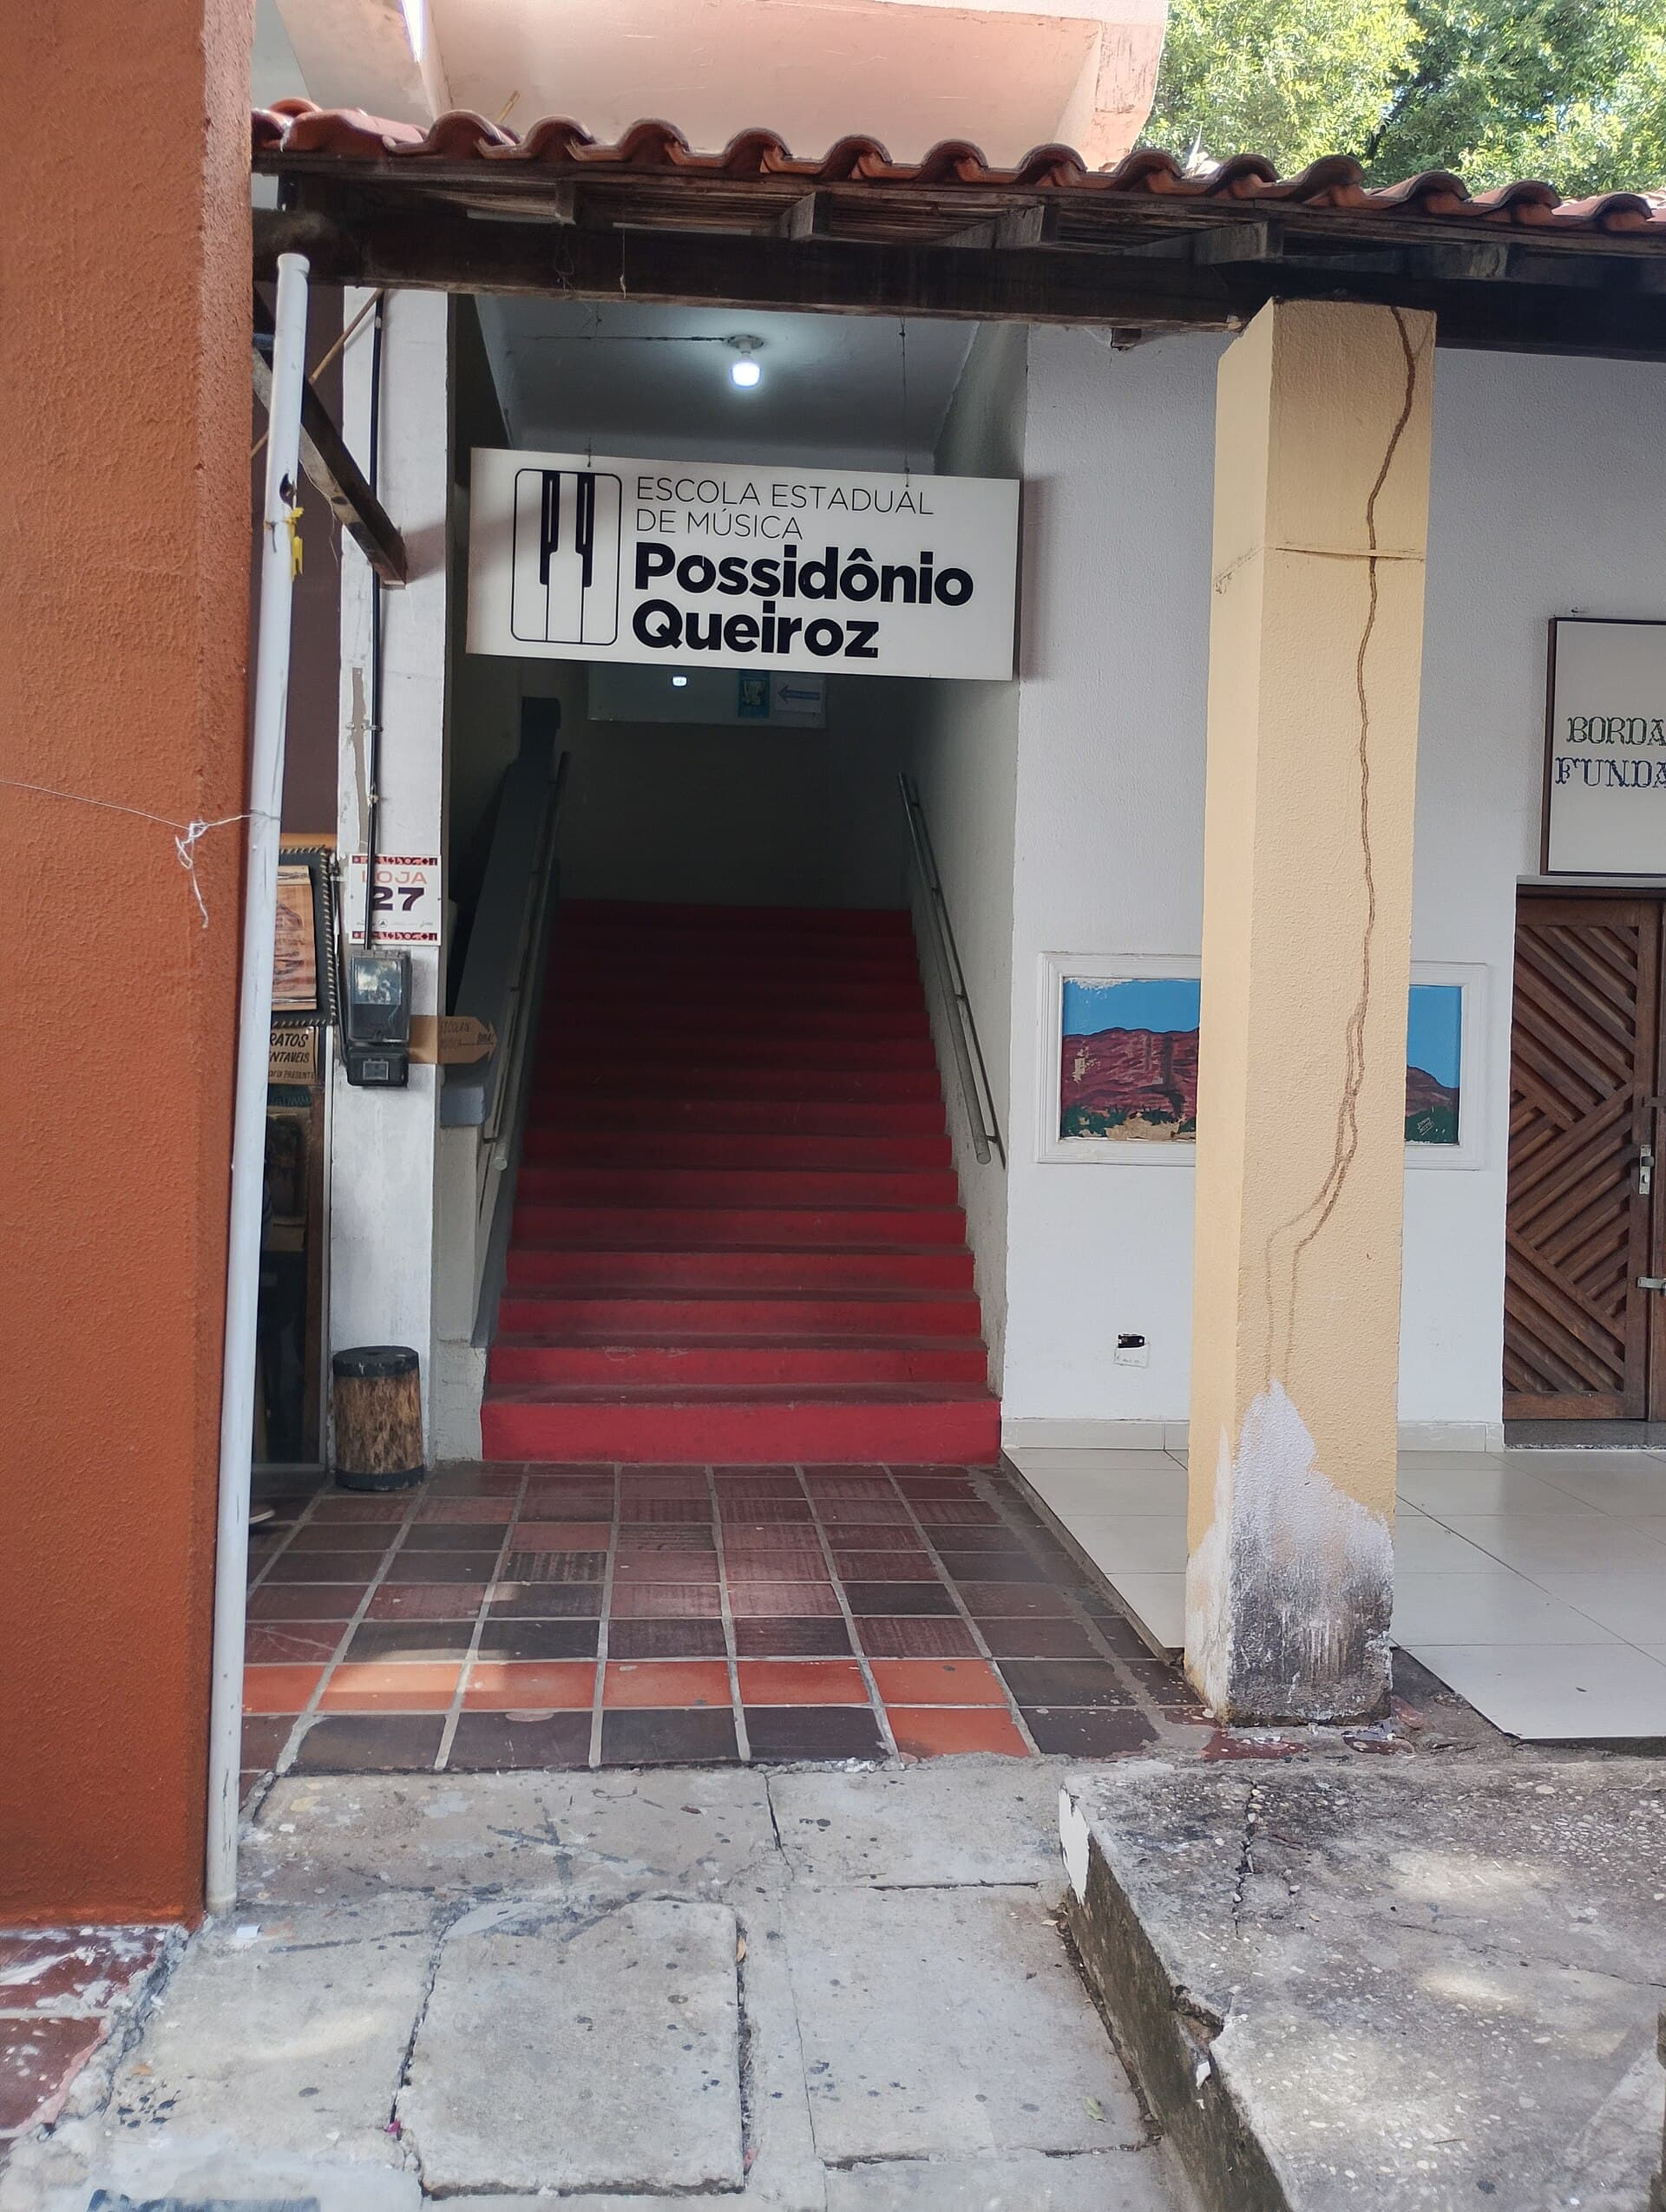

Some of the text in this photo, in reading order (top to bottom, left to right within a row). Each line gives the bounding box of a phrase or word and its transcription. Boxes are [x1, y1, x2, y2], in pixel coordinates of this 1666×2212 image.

[637, 476, 935, 515] ESCOLA ESTADUAL
[636, 507, 803, 540] DE MÚSICA
[634, 541, 974, 606] Possidônio
[632, 599, 879, 659] Queiroz
[1565, 716, 1666, 746] BORDA
[1555, 756, 1666, 789] FUNDA
[372, 885, 425, 912] 27
[269, 1050, 310, 1063] NTAVEIS
